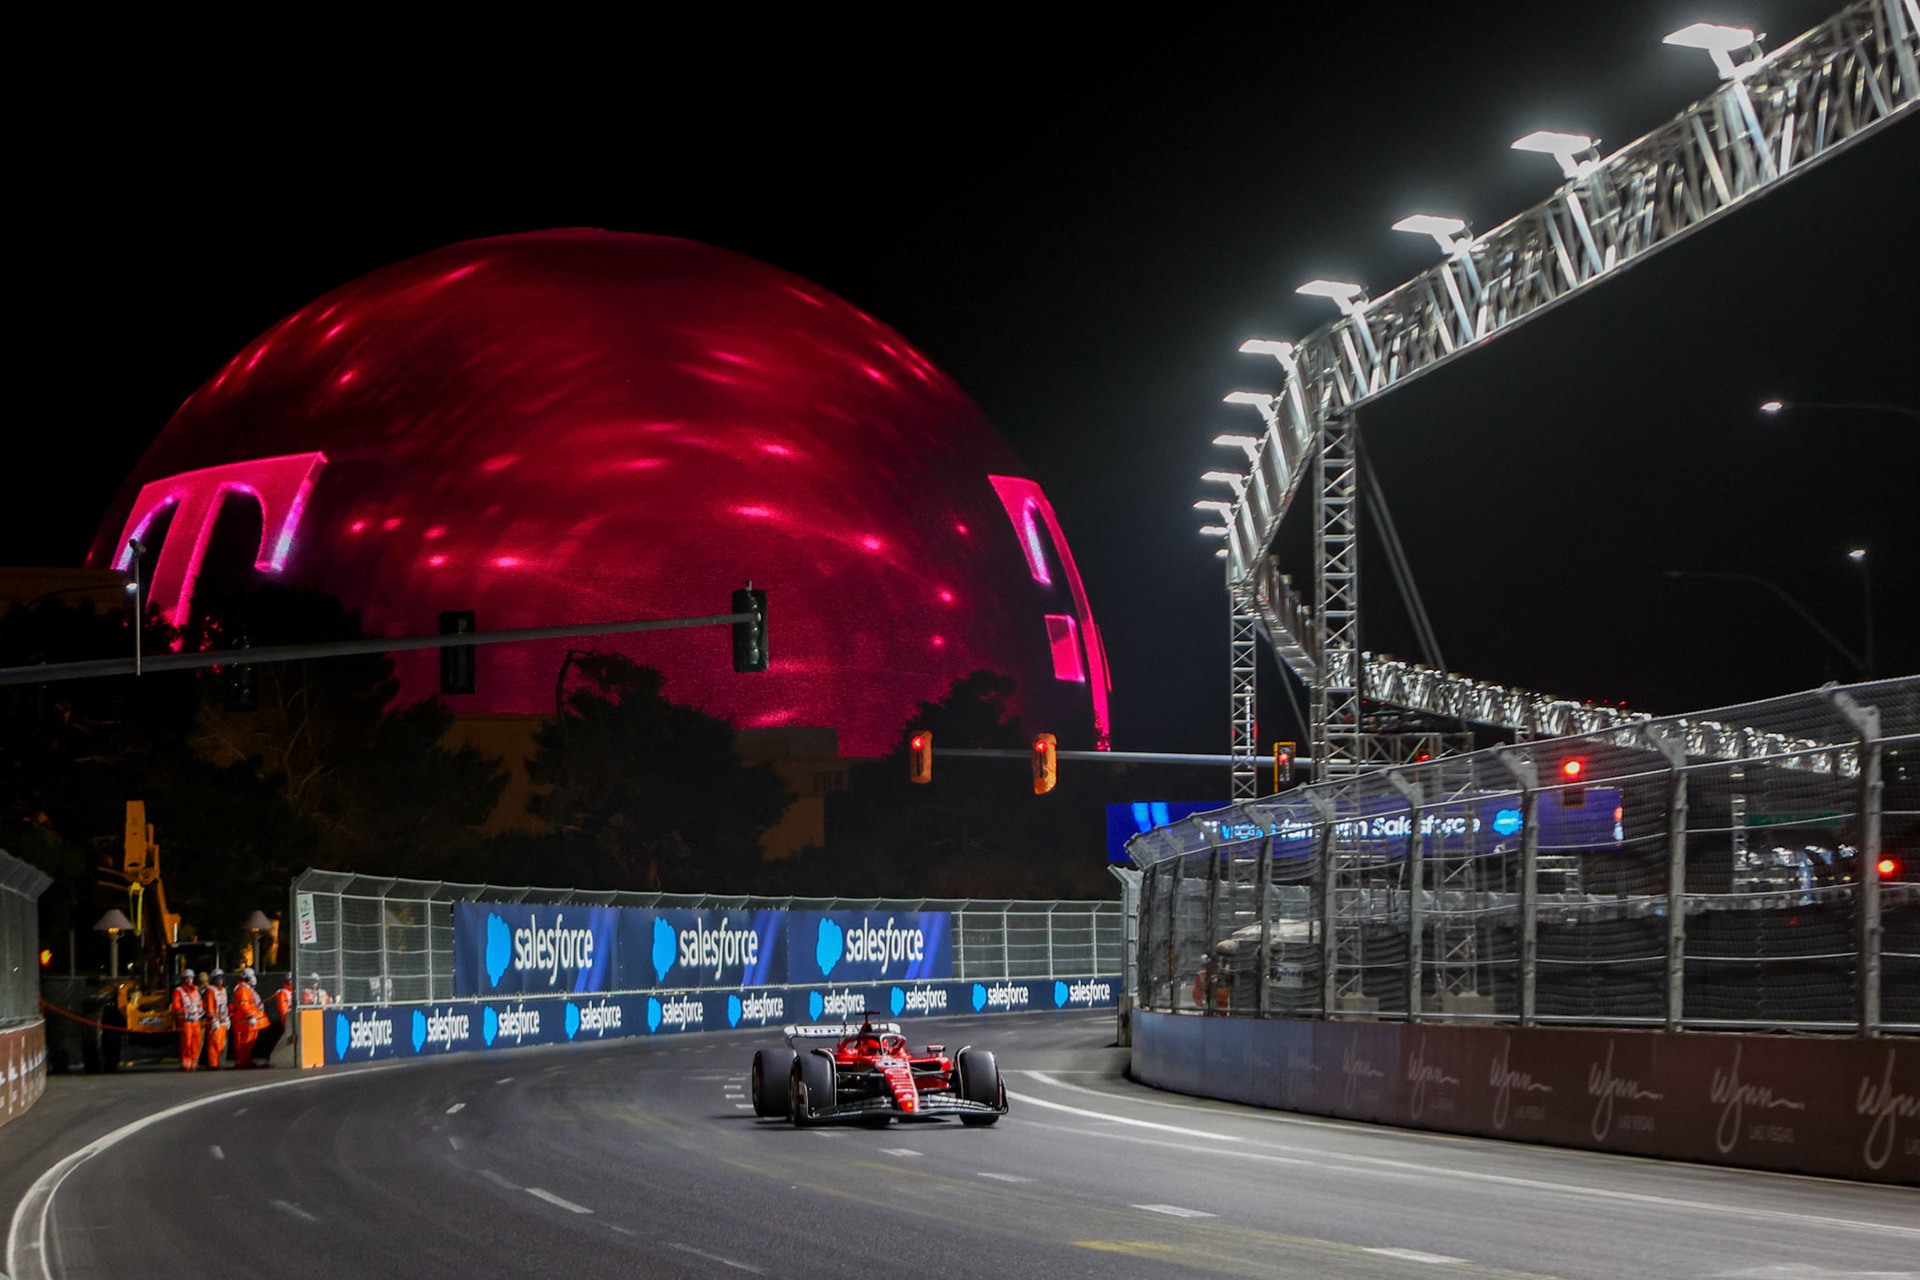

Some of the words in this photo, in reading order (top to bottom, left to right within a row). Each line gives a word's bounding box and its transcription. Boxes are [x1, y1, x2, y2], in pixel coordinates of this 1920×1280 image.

[514, 913, 593, 985] salesforce
[680, 916, 758, 980] salesforce
[846, 917, 924, 974] salesforce
[661, 995, 704, 1031] salesforce
[741, 991, 784, 1025] salesforce
[823, 988, 866, 1021] salesforce
[905, 984, 947, 1015] salesforce
[987, 981, 1029, 1011] salesforce
[1069, 979, 1110, 1008] salesforce
[350, 1011, 393, 1056] salesforce
[427, 1008, 470, 1050] salesforce
[498, 1004, 540, 1047] salesforce
[580, 999, 622, 1037] salesforce
[1855, 1048, 1920, 1170] Wyn
